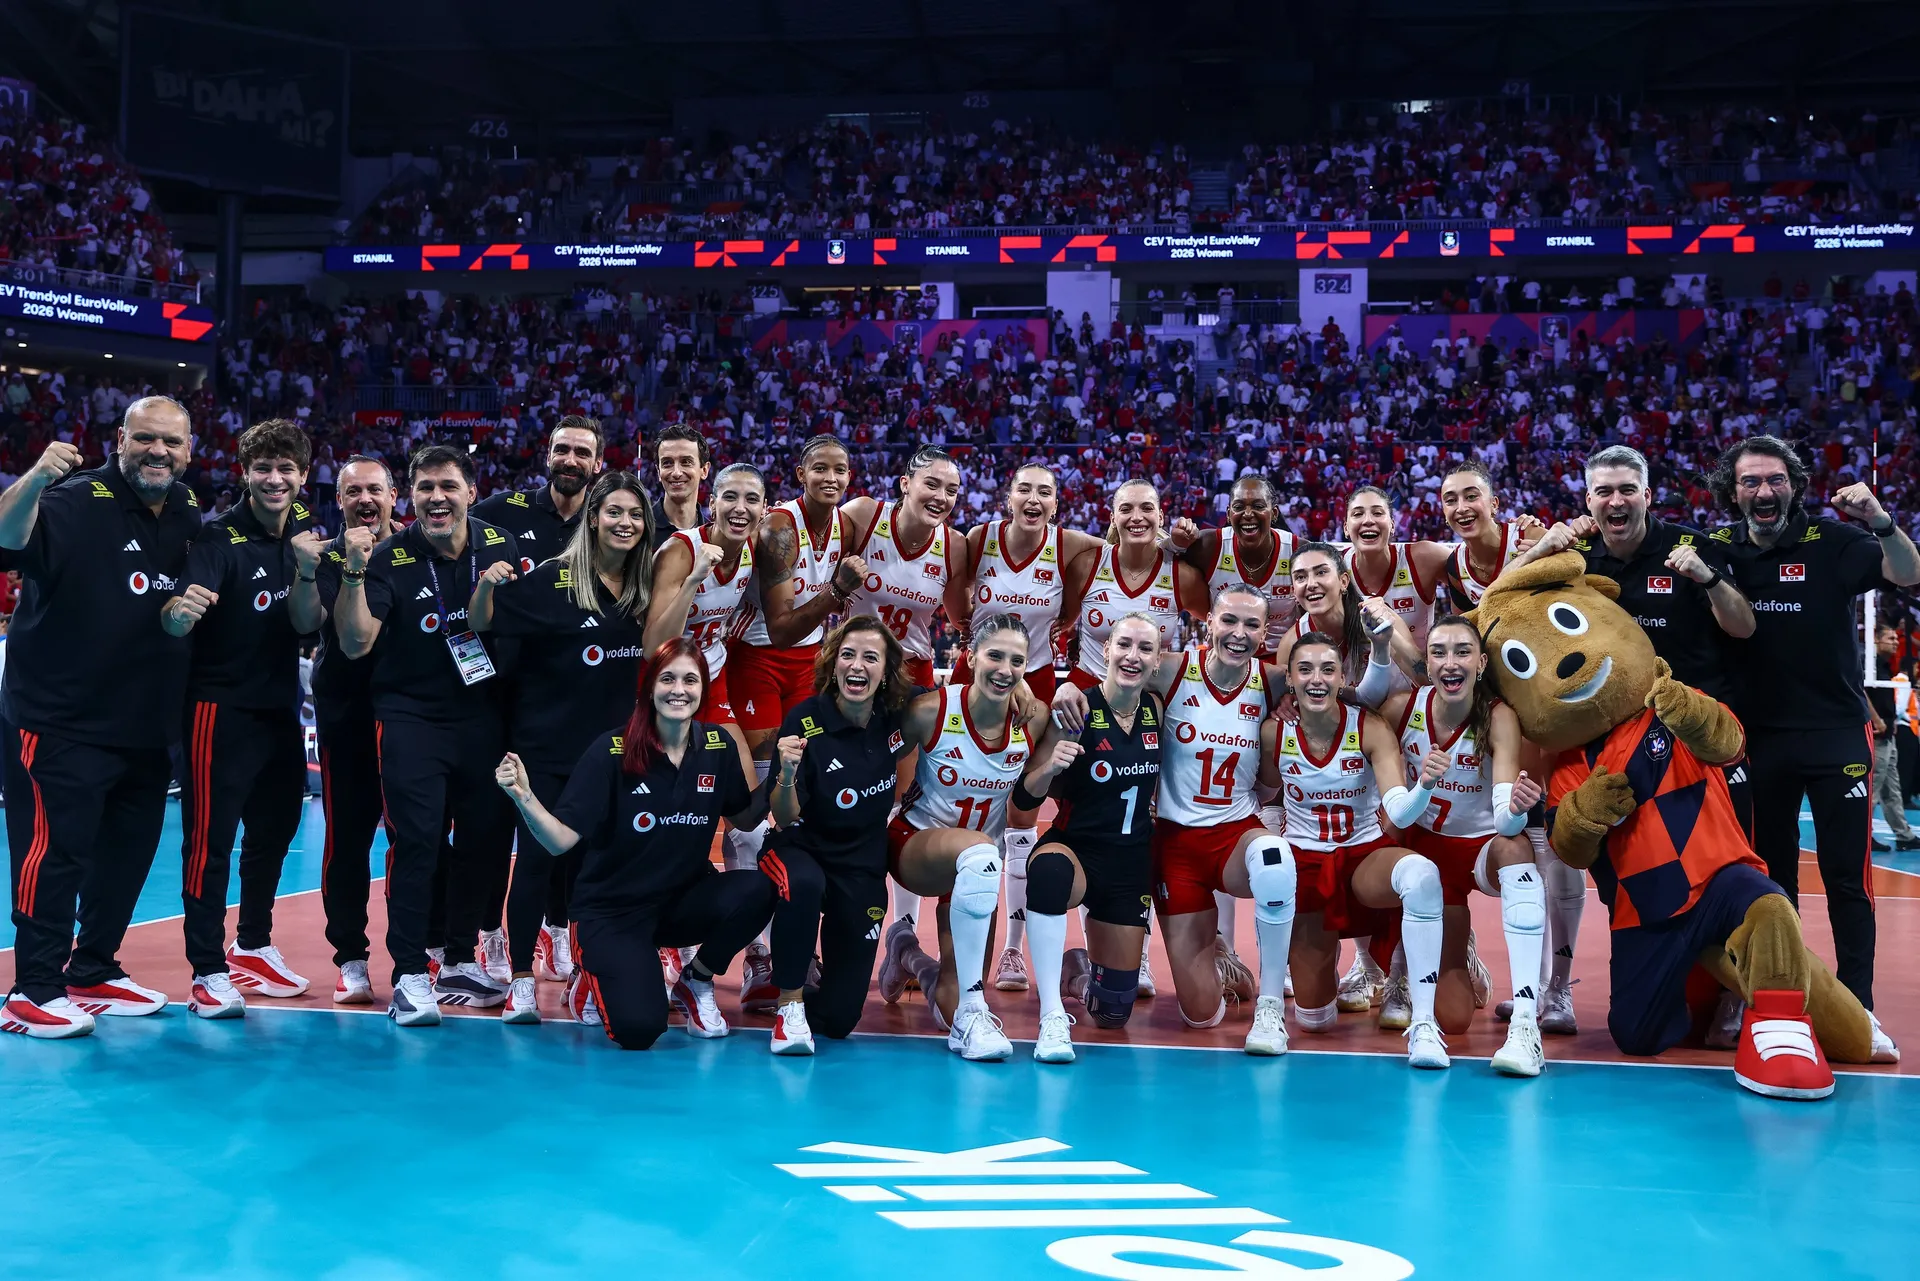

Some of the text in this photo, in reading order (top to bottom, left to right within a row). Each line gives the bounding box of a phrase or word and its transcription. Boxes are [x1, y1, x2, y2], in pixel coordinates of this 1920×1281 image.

[193, 78, 305, 124] DAHA
[963, 95, 989, 108] 425
[468, 120, 508, 138] 426
[1784, 224, 1913, 237] CEV Trendyol EuroVolley
[1144, 235, 1260, 247] CEV Trendyol EuroVolley
[1547, 237, 1594, 246] ISTANBUL
[1814, 238, 1884, 248] 2026 Women
[555, 244, 662, 256] CEV Trendyol EuroVolley
[926, 246, 969, 255] ISTANBUL
[1171, 248, 1233, 258] 2026 Women
[353, 254, 394, 263] ISTANBUL
[579, 257, 636, 266] 2026 Women
[13, 267, 44, 283] 301
[1316, 279, 1349, 293] 324
[17, 286, 71, 305] Trendyol
[74, 295, 138, 316] EuroVolley
[23, 303, 103, 324] 2026 Women
[446, 417, 499, 429] EuroVolley
[881, 522, 887, 530] S
[885, 584, 938, 605] vodafone
[995, 594, 1050, 606] vodafone
[878, 604, 913, 641] 18
[746, 700, 756, 715] 4
[951, 717, 958, 725] S
[1414, 713, 1421, 721] S
[1201, 732, 1259, 749] vodafone
[1288, 739, 1294, 747] S
[1349, 735, 1355, 743] S
[1116, 761, 1159, 776] vodafon
[1195, 748, 1241, 797] 14
[1846, 765, 1866, 774] gratis
[1307, 786, 1367, 800] vodafone
[1435, 779, 1482, 793] dafone
[955, 797, 993, 832] 11
[1120, 786, 1139, 834] 1
[1430, 795, 1452, 832] 7
[659, 812, 709, 826] vodafone
[1311, 804, 1354, 844] 10
